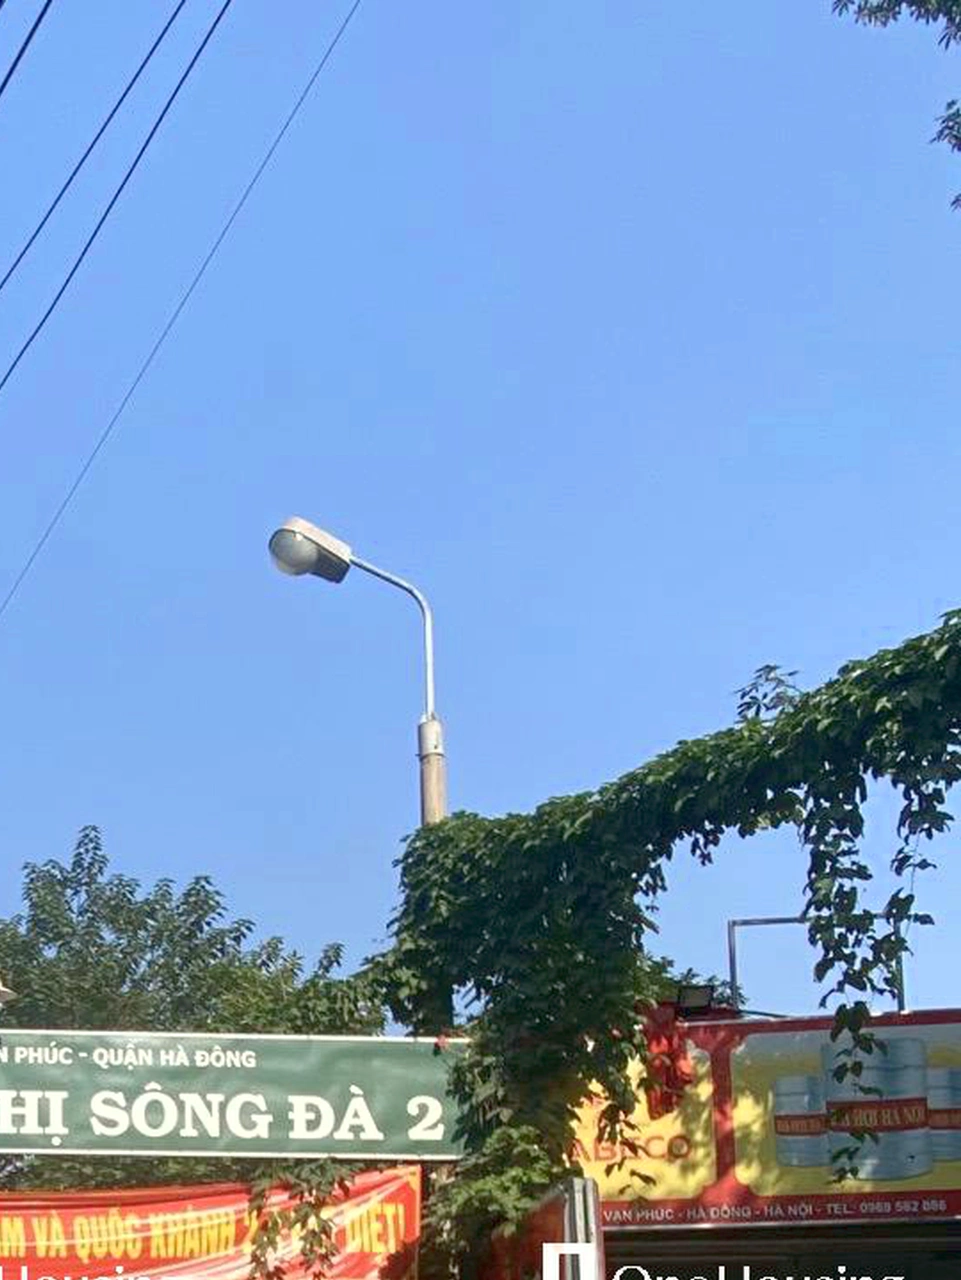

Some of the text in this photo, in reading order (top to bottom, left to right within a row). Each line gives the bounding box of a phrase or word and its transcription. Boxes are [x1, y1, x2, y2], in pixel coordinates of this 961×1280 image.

[15, 1041, 73, 1064] PHÚC
[92, 1043, 153, 1070] QUẬN
[160, 1044, 189, 1066] HÀ
[194, 1045, 256, 1068] ĐÔNG
[90, 1081, 273, 1138] SÔNG
[287, 1084, 384, 1140] ĐÀ
[406, 1095, 445, 1140] 2
[31, 1209, 68, 1258] VÀ
